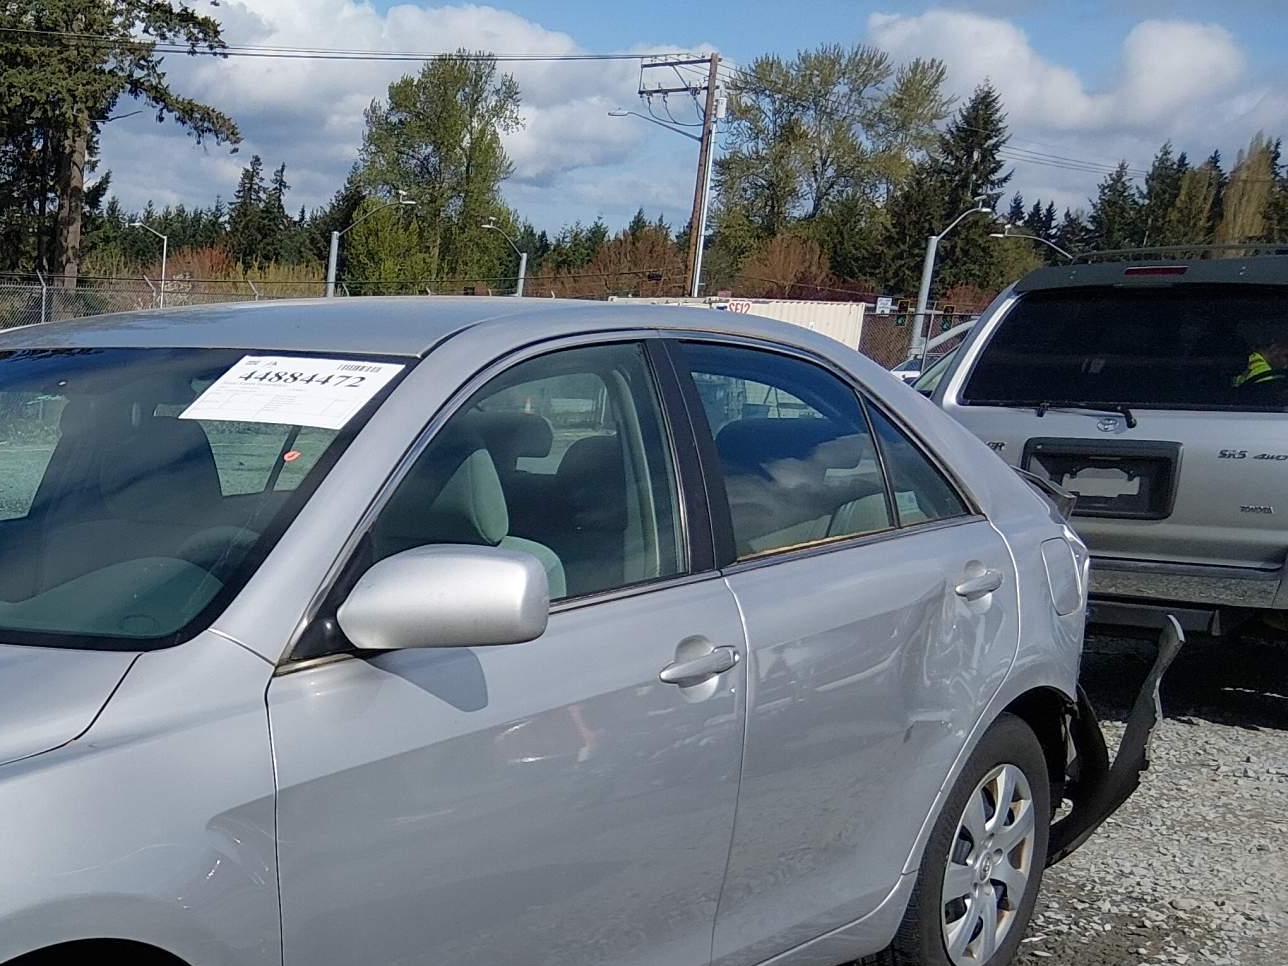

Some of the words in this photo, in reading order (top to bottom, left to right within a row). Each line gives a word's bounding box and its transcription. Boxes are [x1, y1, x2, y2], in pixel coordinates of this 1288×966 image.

[239, 369, 366, 388] 44884472
[1217, 449, 1248, 459] SR5
[1240, 505, 1273, 514] TOYOTA
